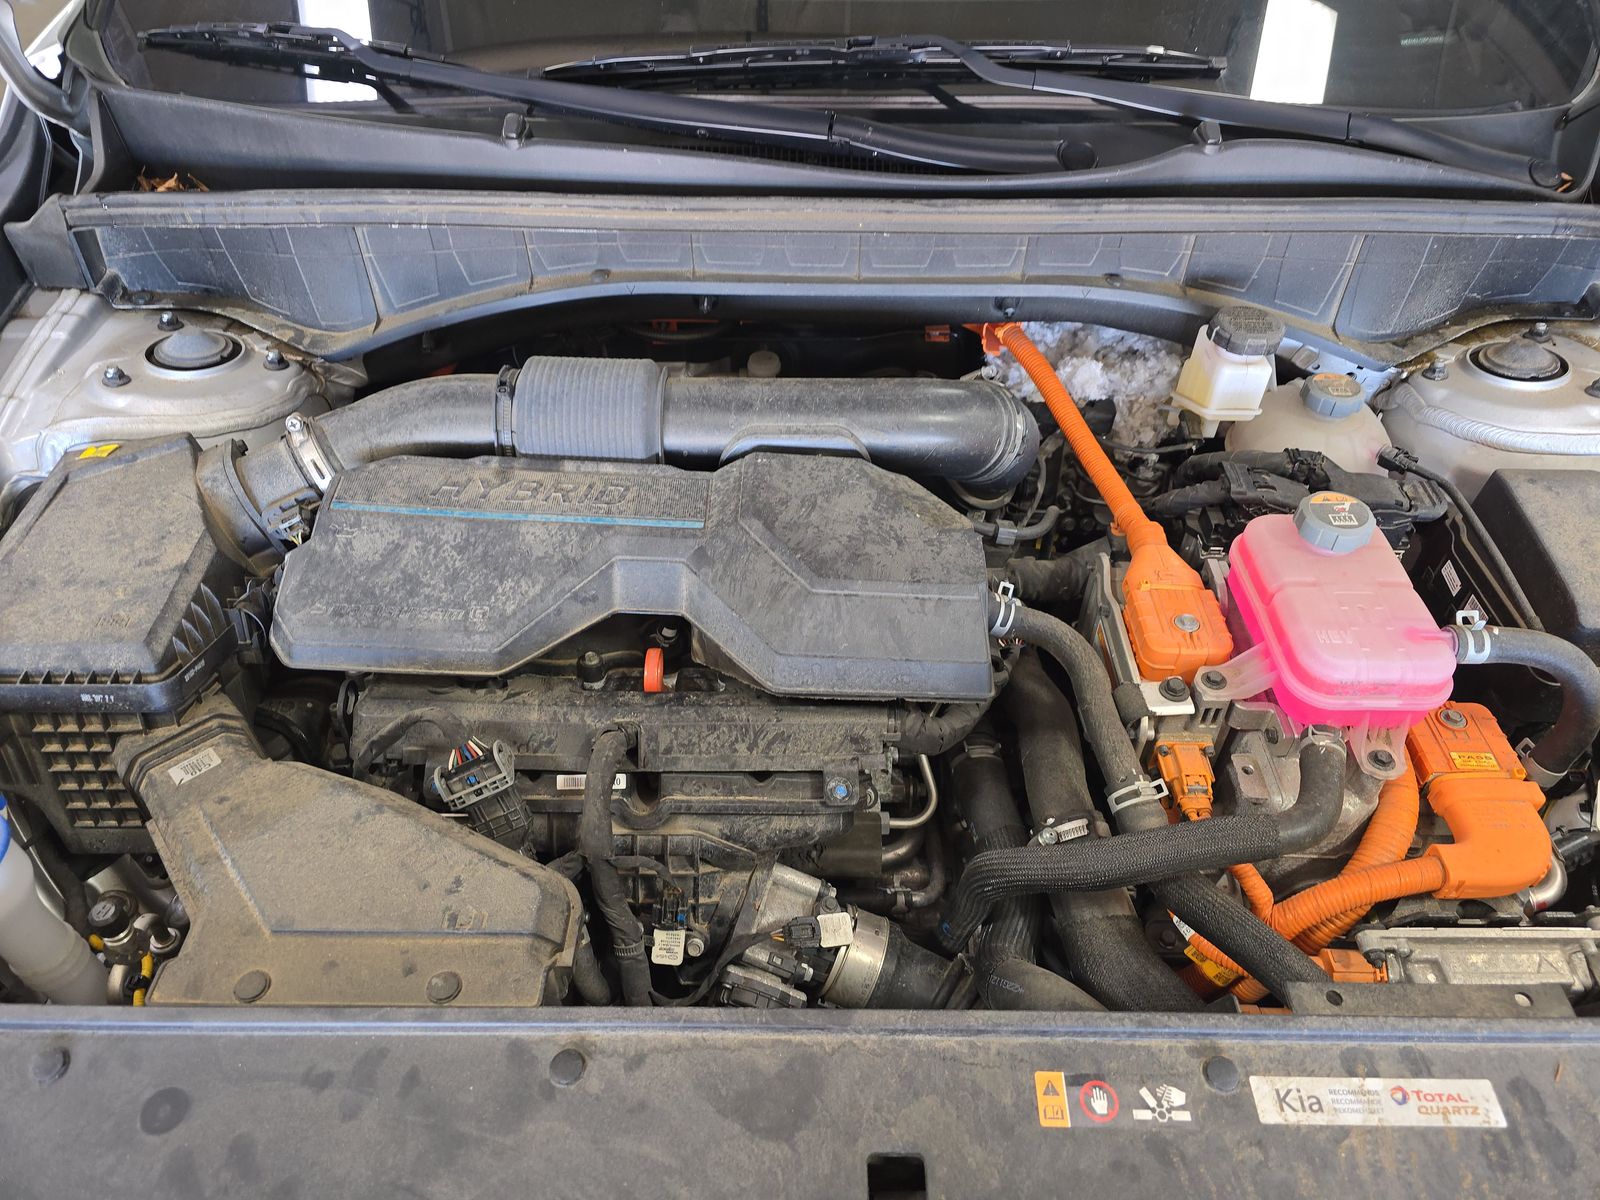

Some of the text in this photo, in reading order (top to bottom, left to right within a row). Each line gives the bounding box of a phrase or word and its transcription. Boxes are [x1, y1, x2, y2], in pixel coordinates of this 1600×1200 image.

[428, 477, 631, 505] HYBRID
[1274, 1088, 1324, 1113] Kia
[1411, 1089, 1469, 1103] TOTAL
[1417, 1105, 1482, 1116] QUARTZ
